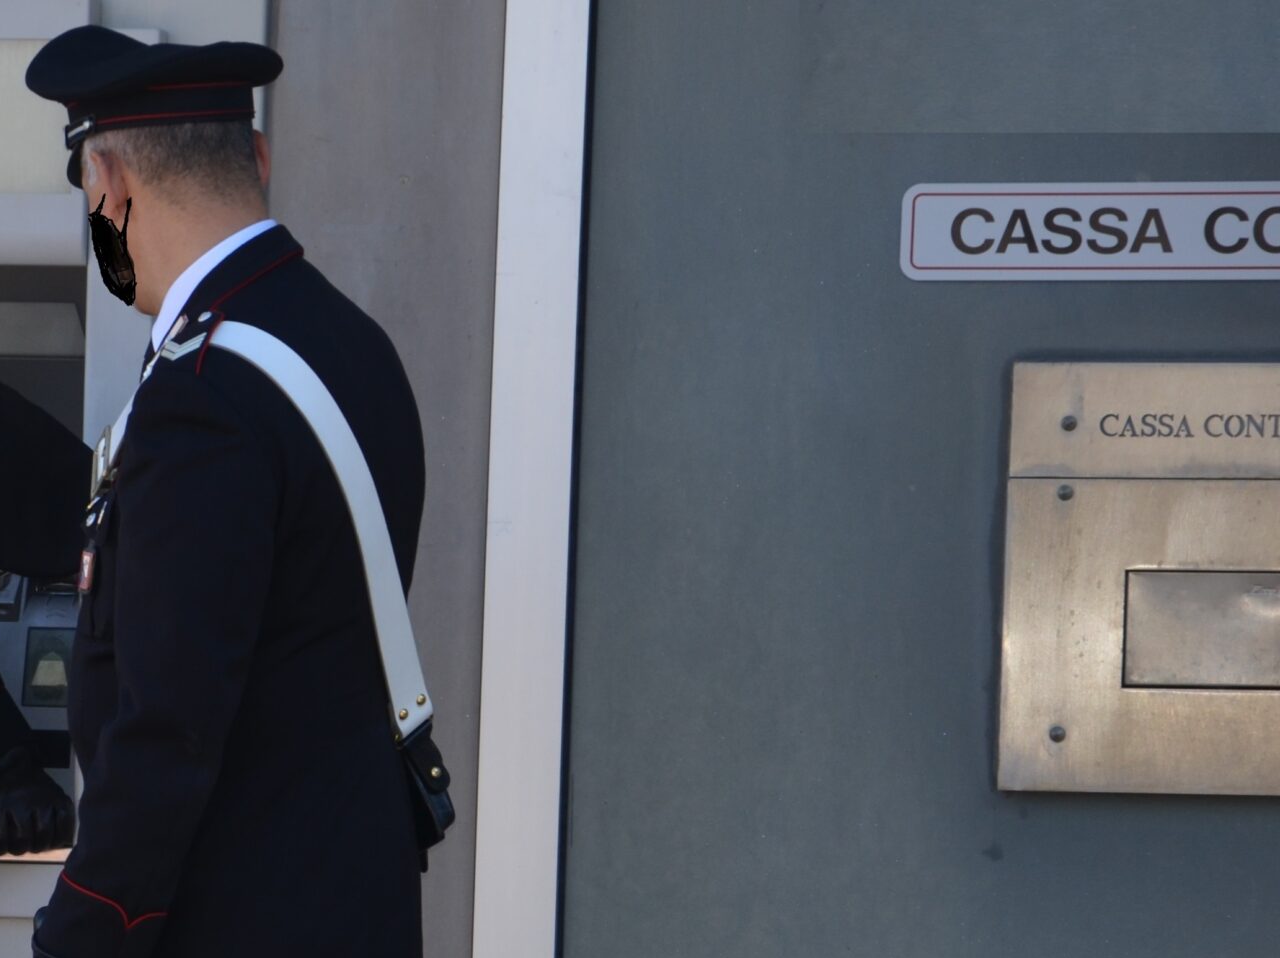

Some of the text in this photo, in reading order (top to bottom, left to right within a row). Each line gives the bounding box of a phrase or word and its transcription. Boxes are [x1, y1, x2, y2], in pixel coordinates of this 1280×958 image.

[950, 206, 1173, 255] CASSA
[1099, 413, 1280, 438] CASSA CONT
